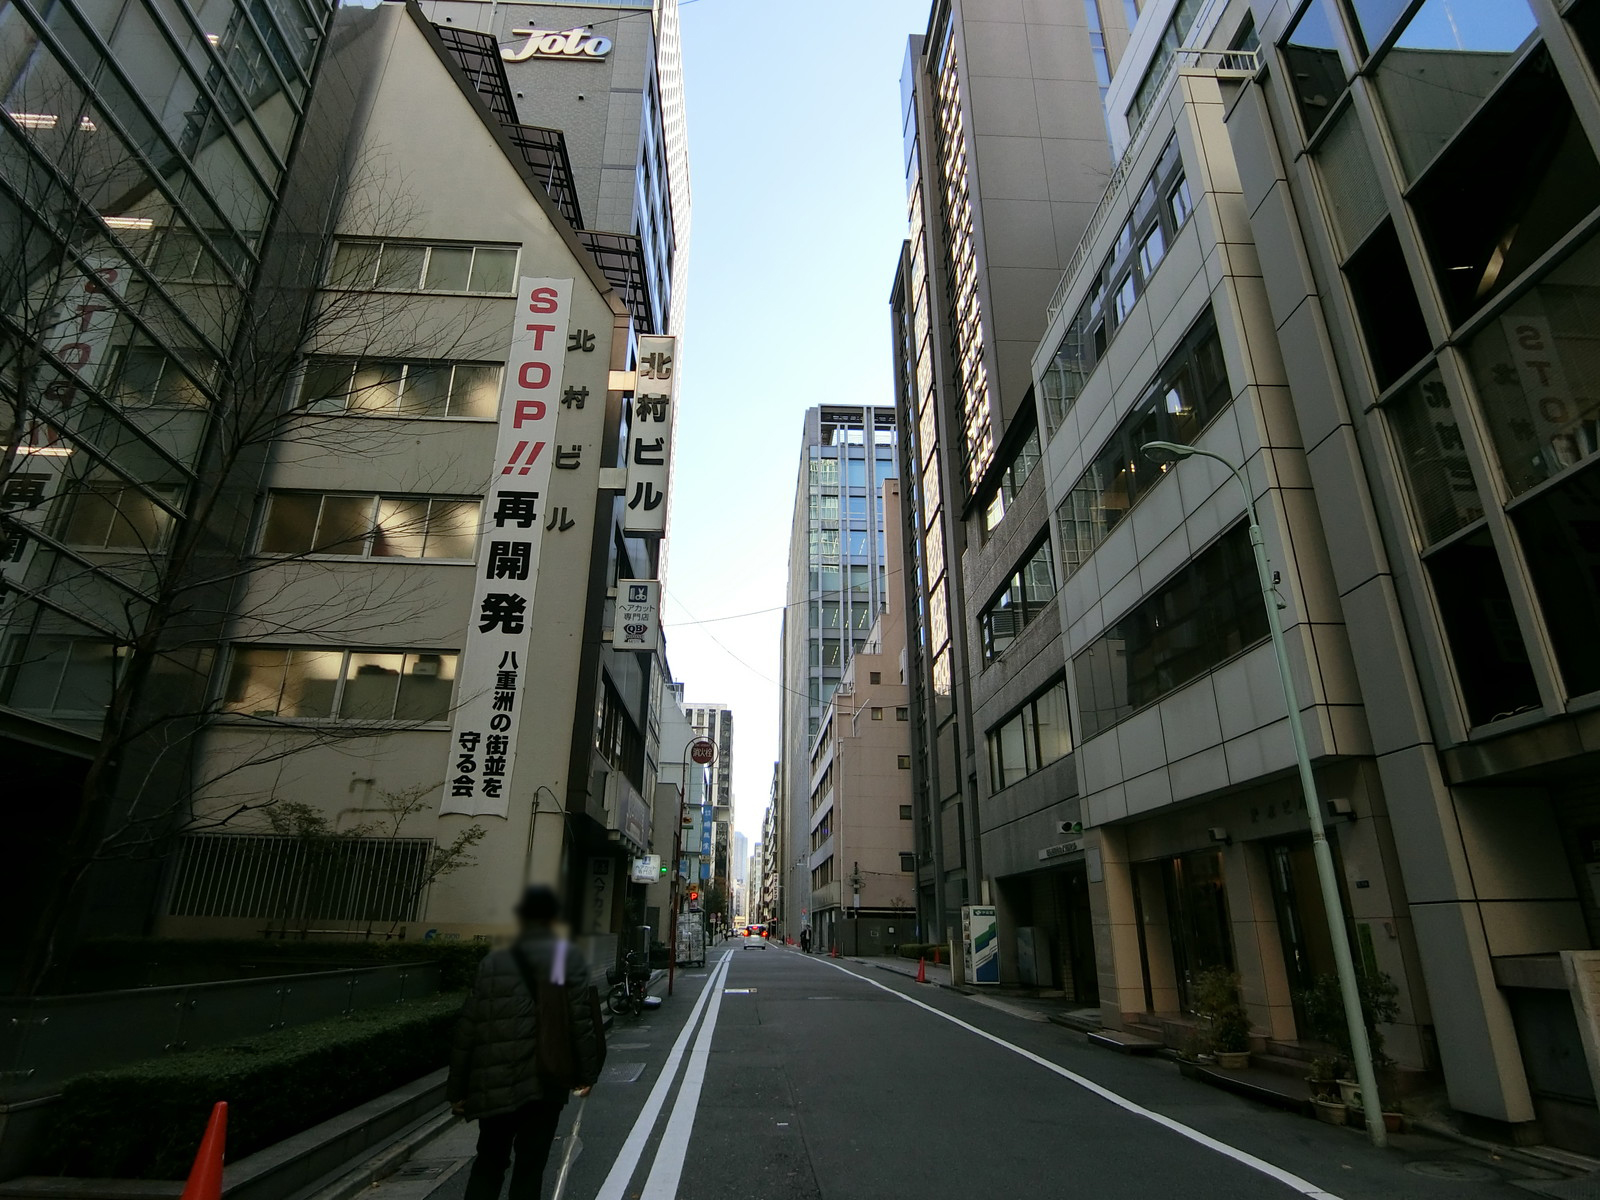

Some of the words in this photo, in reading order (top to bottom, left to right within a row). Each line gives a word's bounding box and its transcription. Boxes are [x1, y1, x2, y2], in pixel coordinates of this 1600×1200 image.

[500, 27, 612, 62] Joto
[501, 287, 558, 476] STOP!!
[546, 328, 596, 533] 北村ビル
[627, 351, 672, 512] 北村ビル
[478, 490, 537, 635] 再開発
[619, 604, 655, 612] ヘアカット
[624, 613, 649, 621] 専門店
[628, 624, 643, 634] QB
[481, 650, 519, 798] 八重洲の街並を
[692, 747, 713, 758] 消火栓
[451, 731, 481, 798] 守る会
